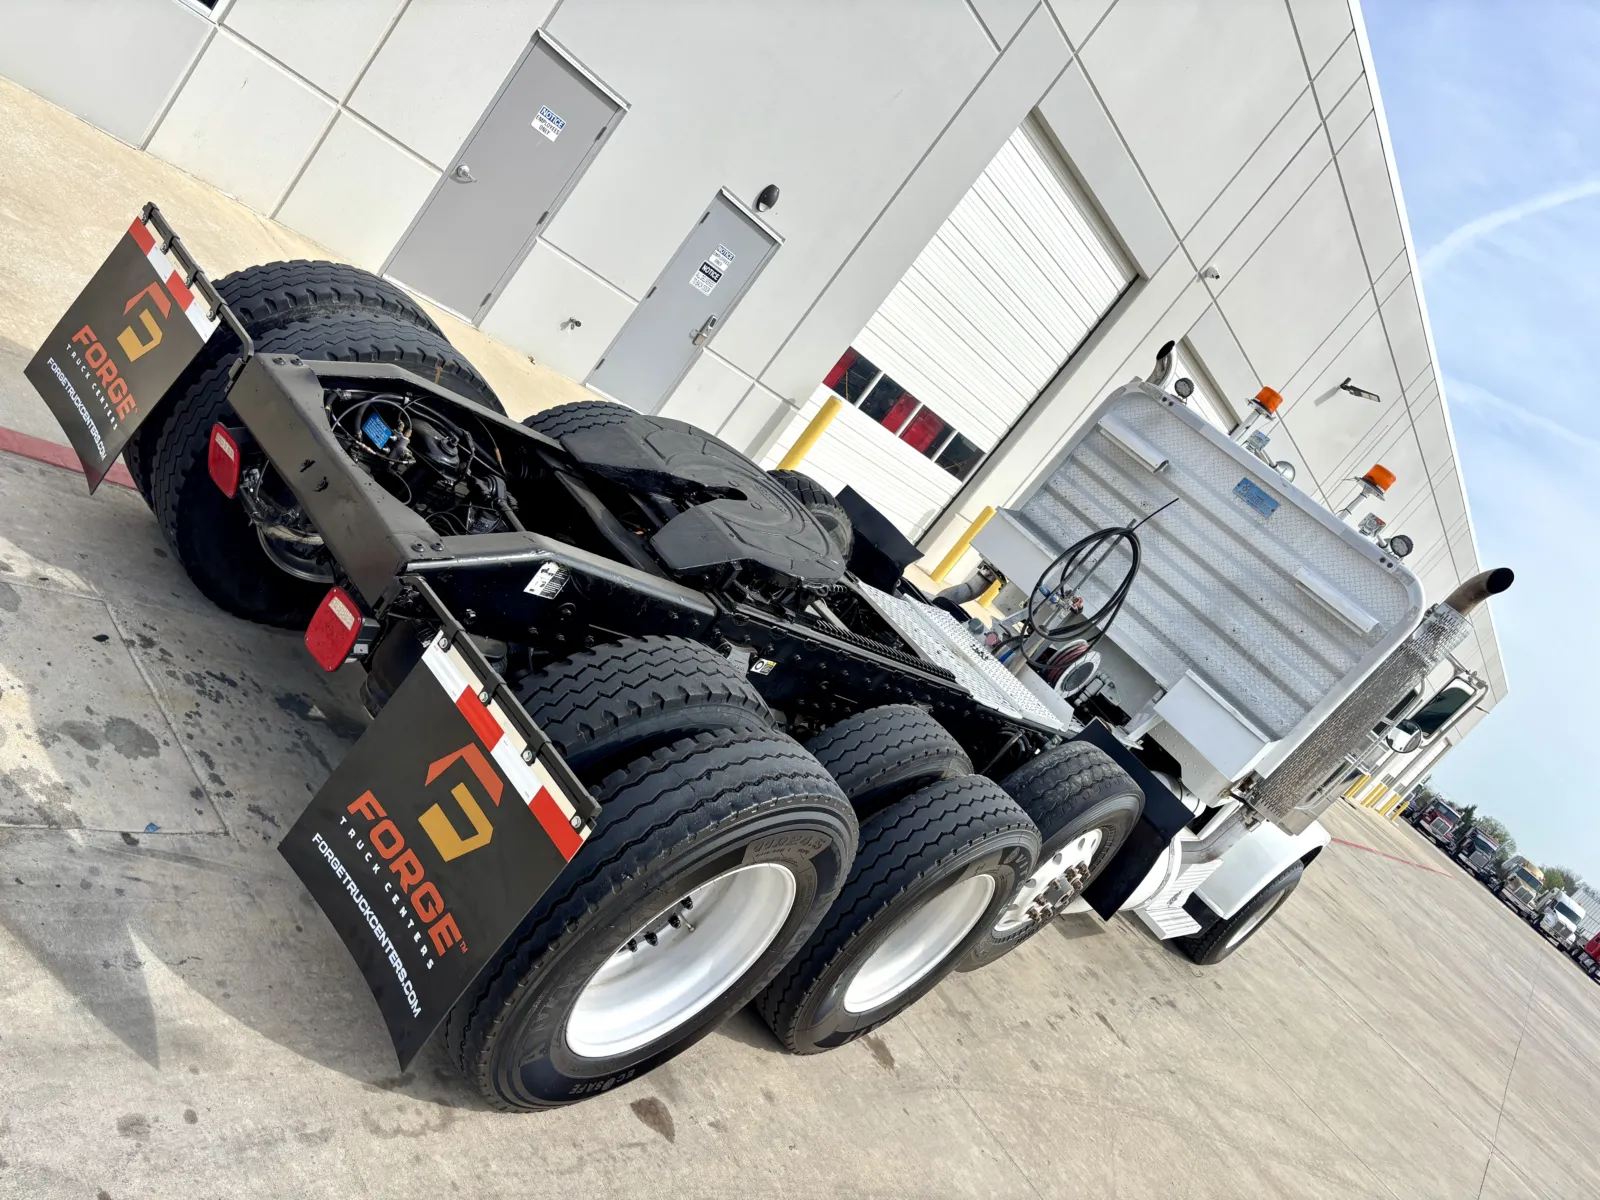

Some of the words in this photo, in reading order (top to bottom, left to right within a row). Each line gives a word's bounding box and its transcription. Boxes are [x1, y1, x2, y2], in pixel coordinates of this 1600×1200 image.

[536, 115, 561, 135] EMPLOYEES
[539, 125, 550, 135] ONLY
[541, 108, 565, 129] NOTICE
[701, 265, 720, 281] NOTICE
[717, 246, 734, 261] NOTICE
[47, 357, 107, 461] FORGETRUCKCENTERS.COM
[66, 343, 91, 380] TRUCK
[92, 382, 118, 430] CENTERS
[72, 325, 137, 421] FORGE
[339, 816, 380, 874] TRUCK
[384, 882, 434, 969] CENTERS
[347, 790, 462, 956] FORGE
[312, 832, 421, 1018] FORGETRUCKCENTERS.COM
